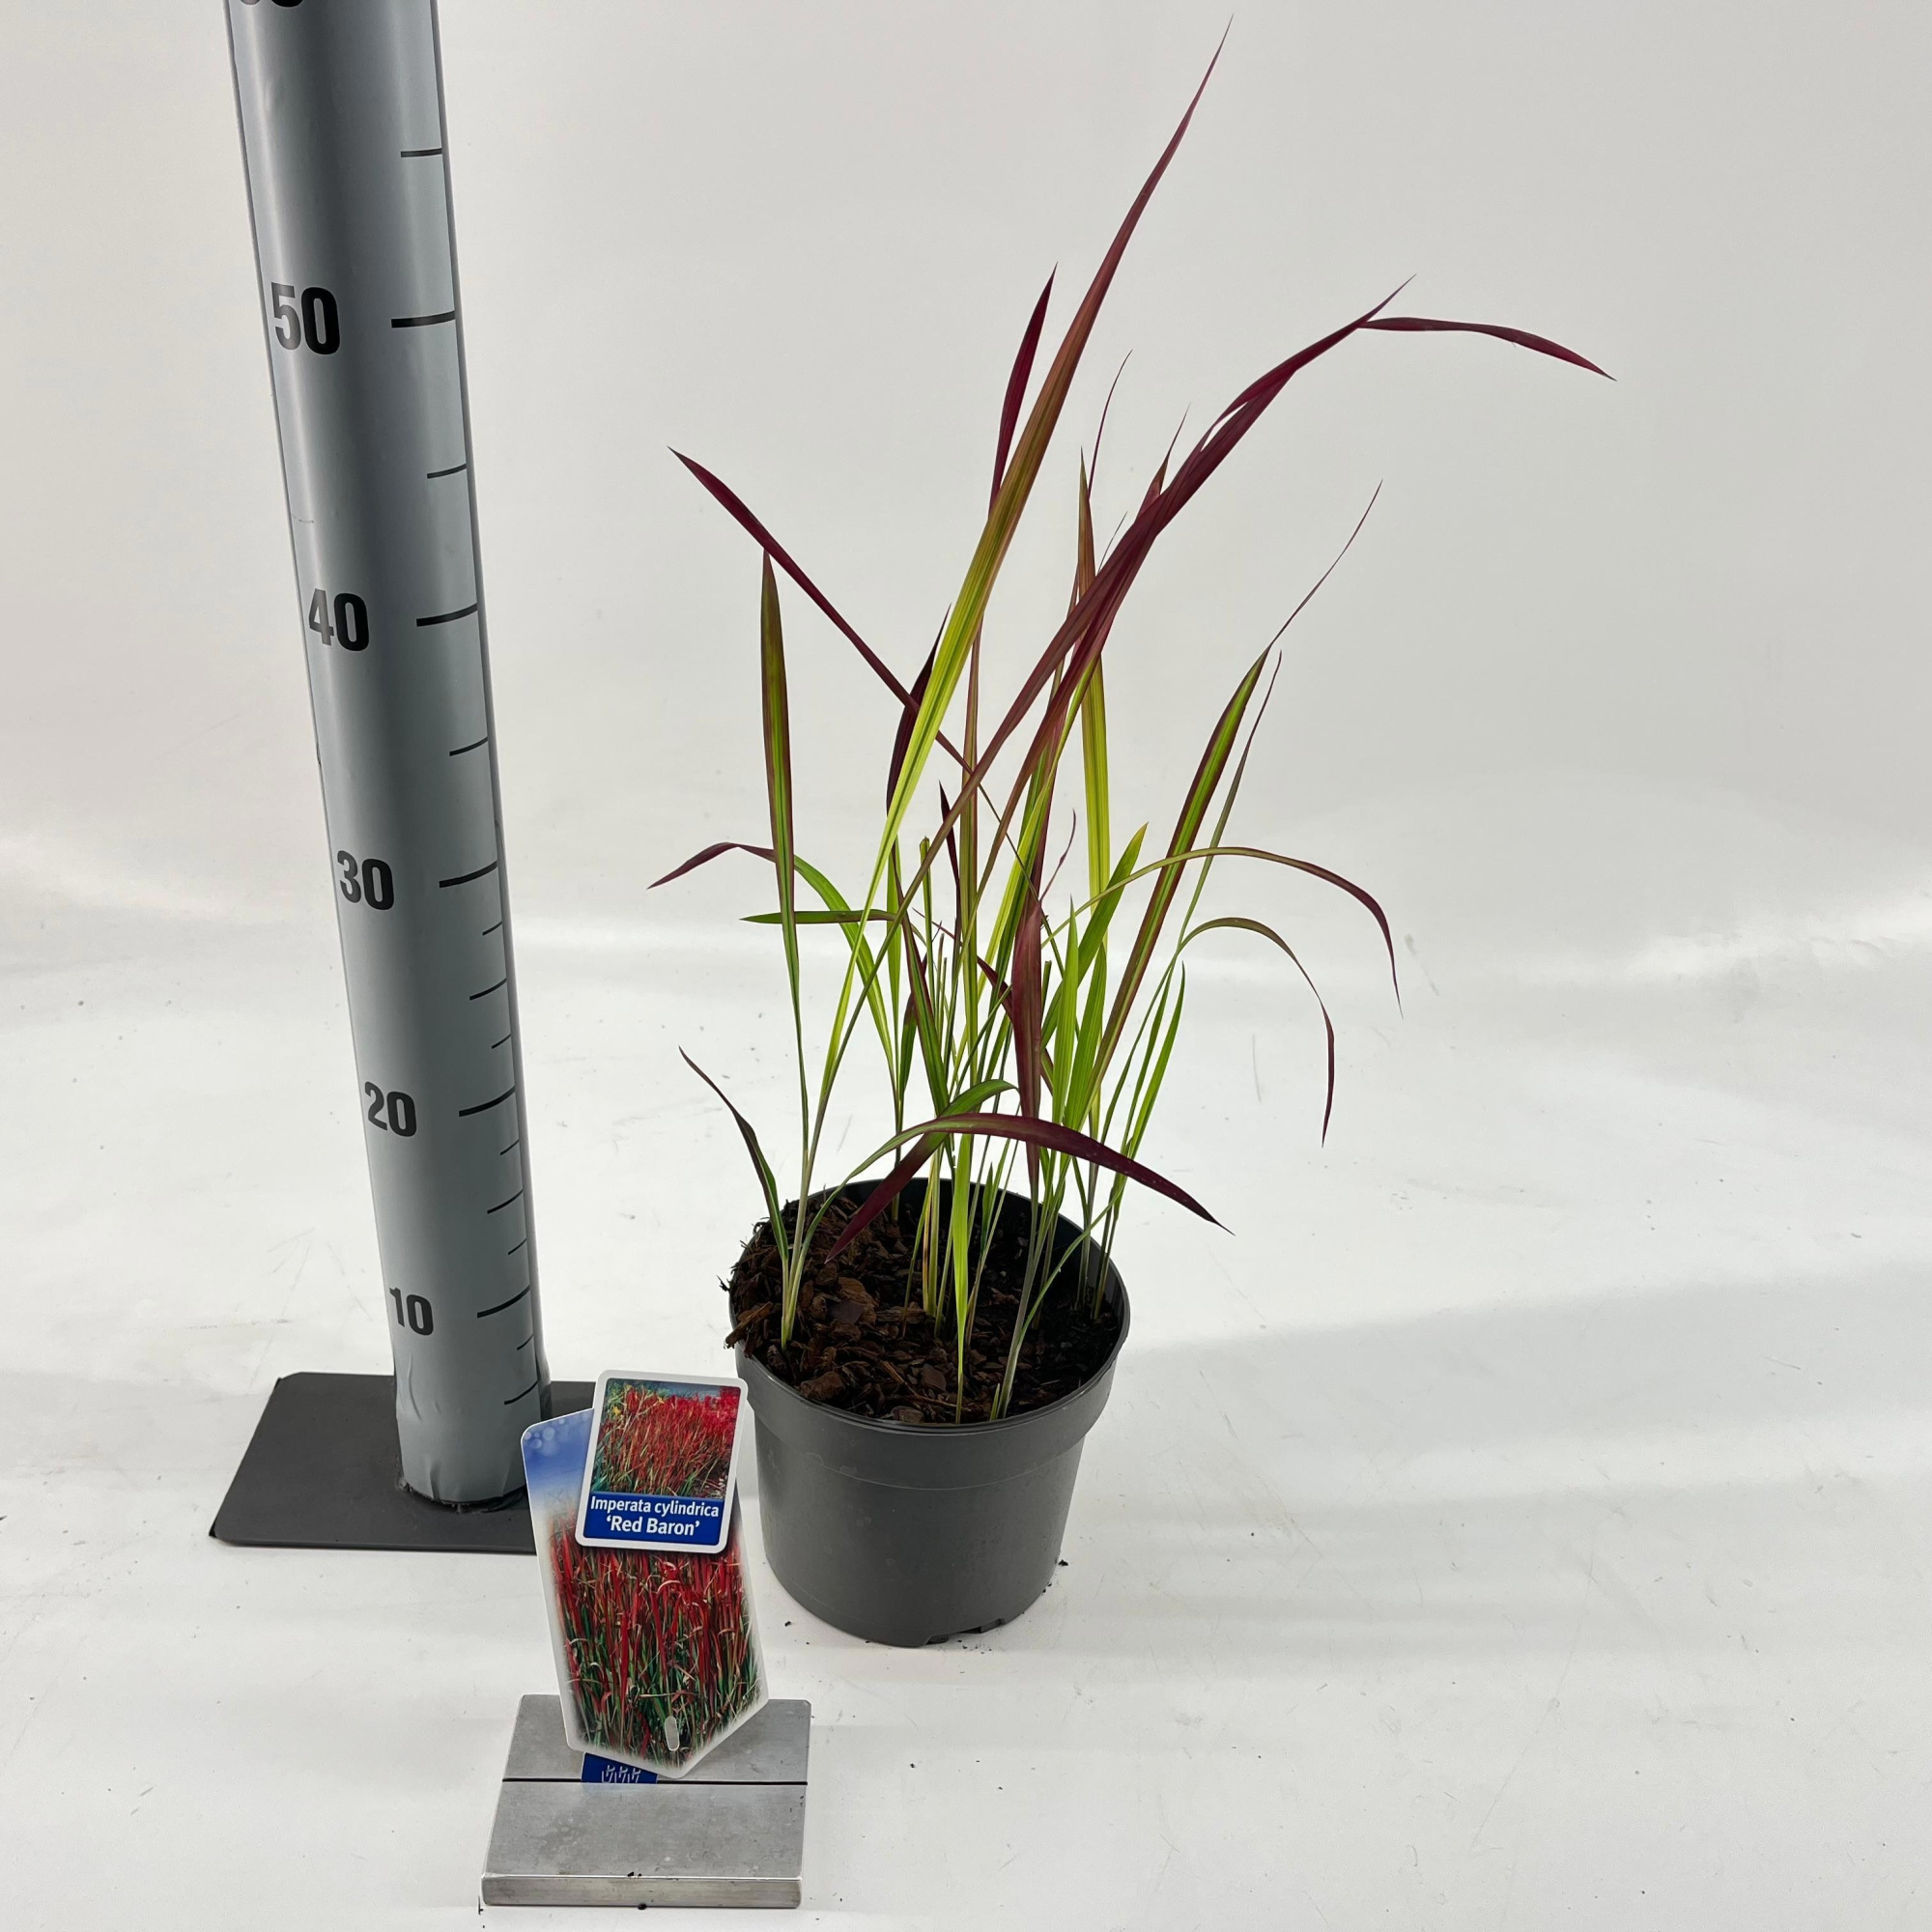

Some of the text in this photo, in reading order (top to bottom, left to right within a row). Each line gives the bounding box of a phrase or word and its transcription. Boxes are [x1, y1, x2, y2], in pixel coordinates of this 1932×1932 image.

[271, 282, 340, 355] 50
[309, 588, 369, 651] 40
[337, 850, 394, 910] 30
[365, 1081, 416, 1137] 20
[389, 1287, 434, 1336] 10
[590, 1496, 720, 1517] Imperata cylindrica
[606, 1515, 700, 1536] ‘Red Baron’
